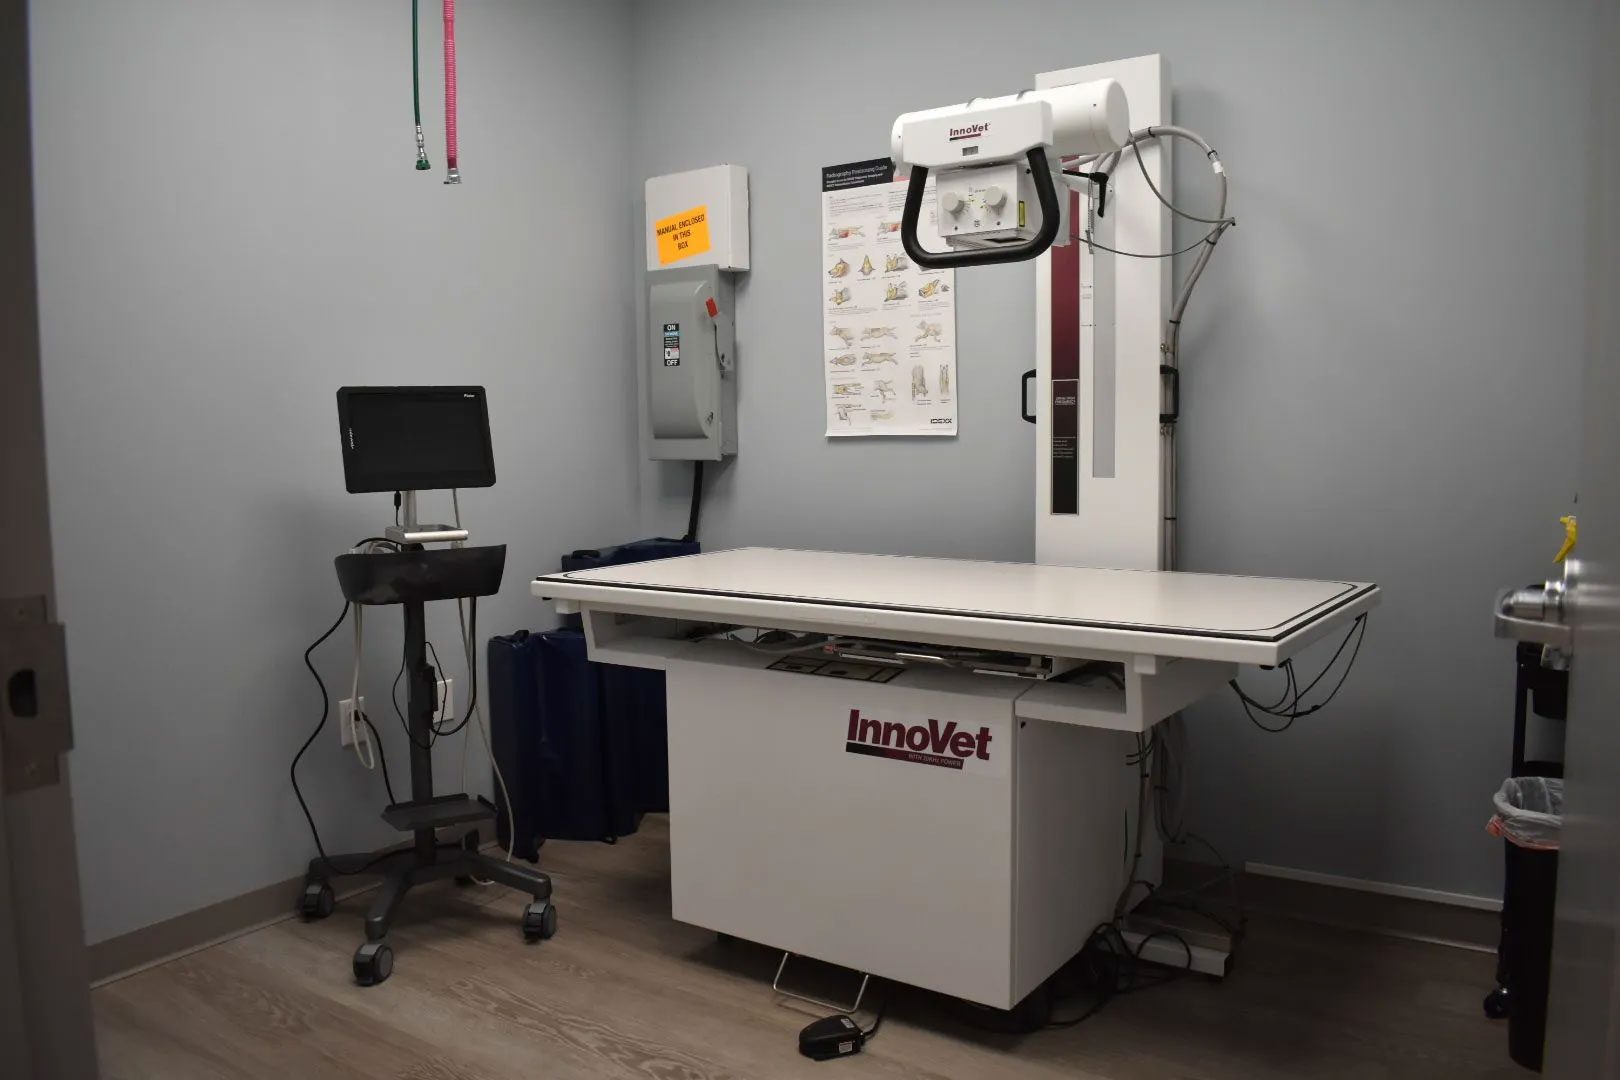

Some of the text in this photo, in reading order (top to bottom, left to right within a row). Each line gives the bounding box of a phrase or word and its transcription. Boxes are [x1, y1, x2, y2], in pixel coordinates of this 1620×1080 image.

[949, 122, 989, 136] InnoVet
[826, 170, 852, 178] Radiography
[656, 214, 704, 236] MANUAL ENCLOSED
[680, 230, 690, 239] THIS
[678, 241, 688, 250] BOX
[848, 709, 992, 760] InnoVet
[940, 758, 961, 766] POWER
